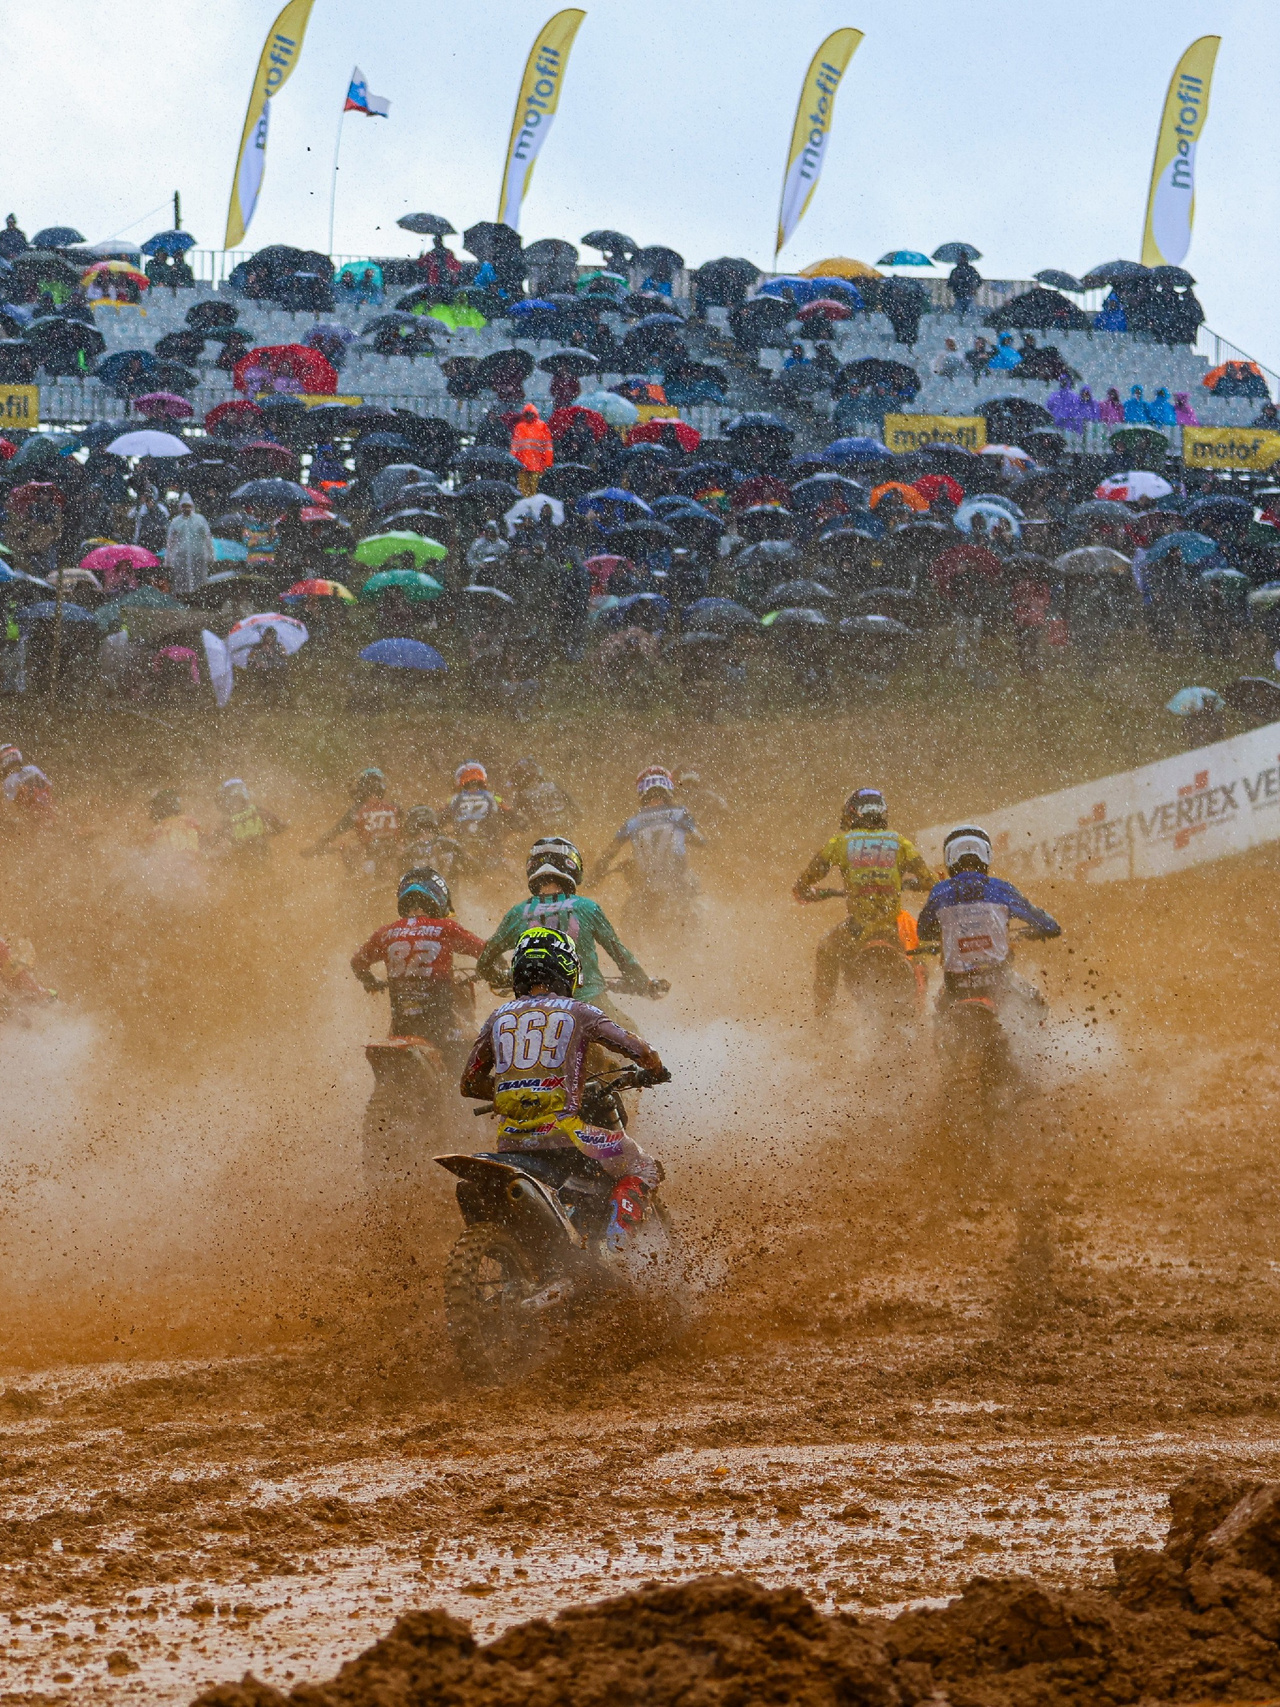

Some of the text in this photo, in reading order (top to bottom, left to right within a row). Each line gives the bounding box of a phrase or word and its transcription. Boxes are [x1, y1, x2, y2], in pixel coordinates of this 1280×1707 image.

[515, 46, 560, 160] motofil
[800, 62, 842, 180] motofil
[1171, 74, 1203, 189] motofil
[1137, 781, 1239, 838] VERTEX
[493, 1010, 575, 1074] 669
[498, 1079, 540, 1091] DIANA
